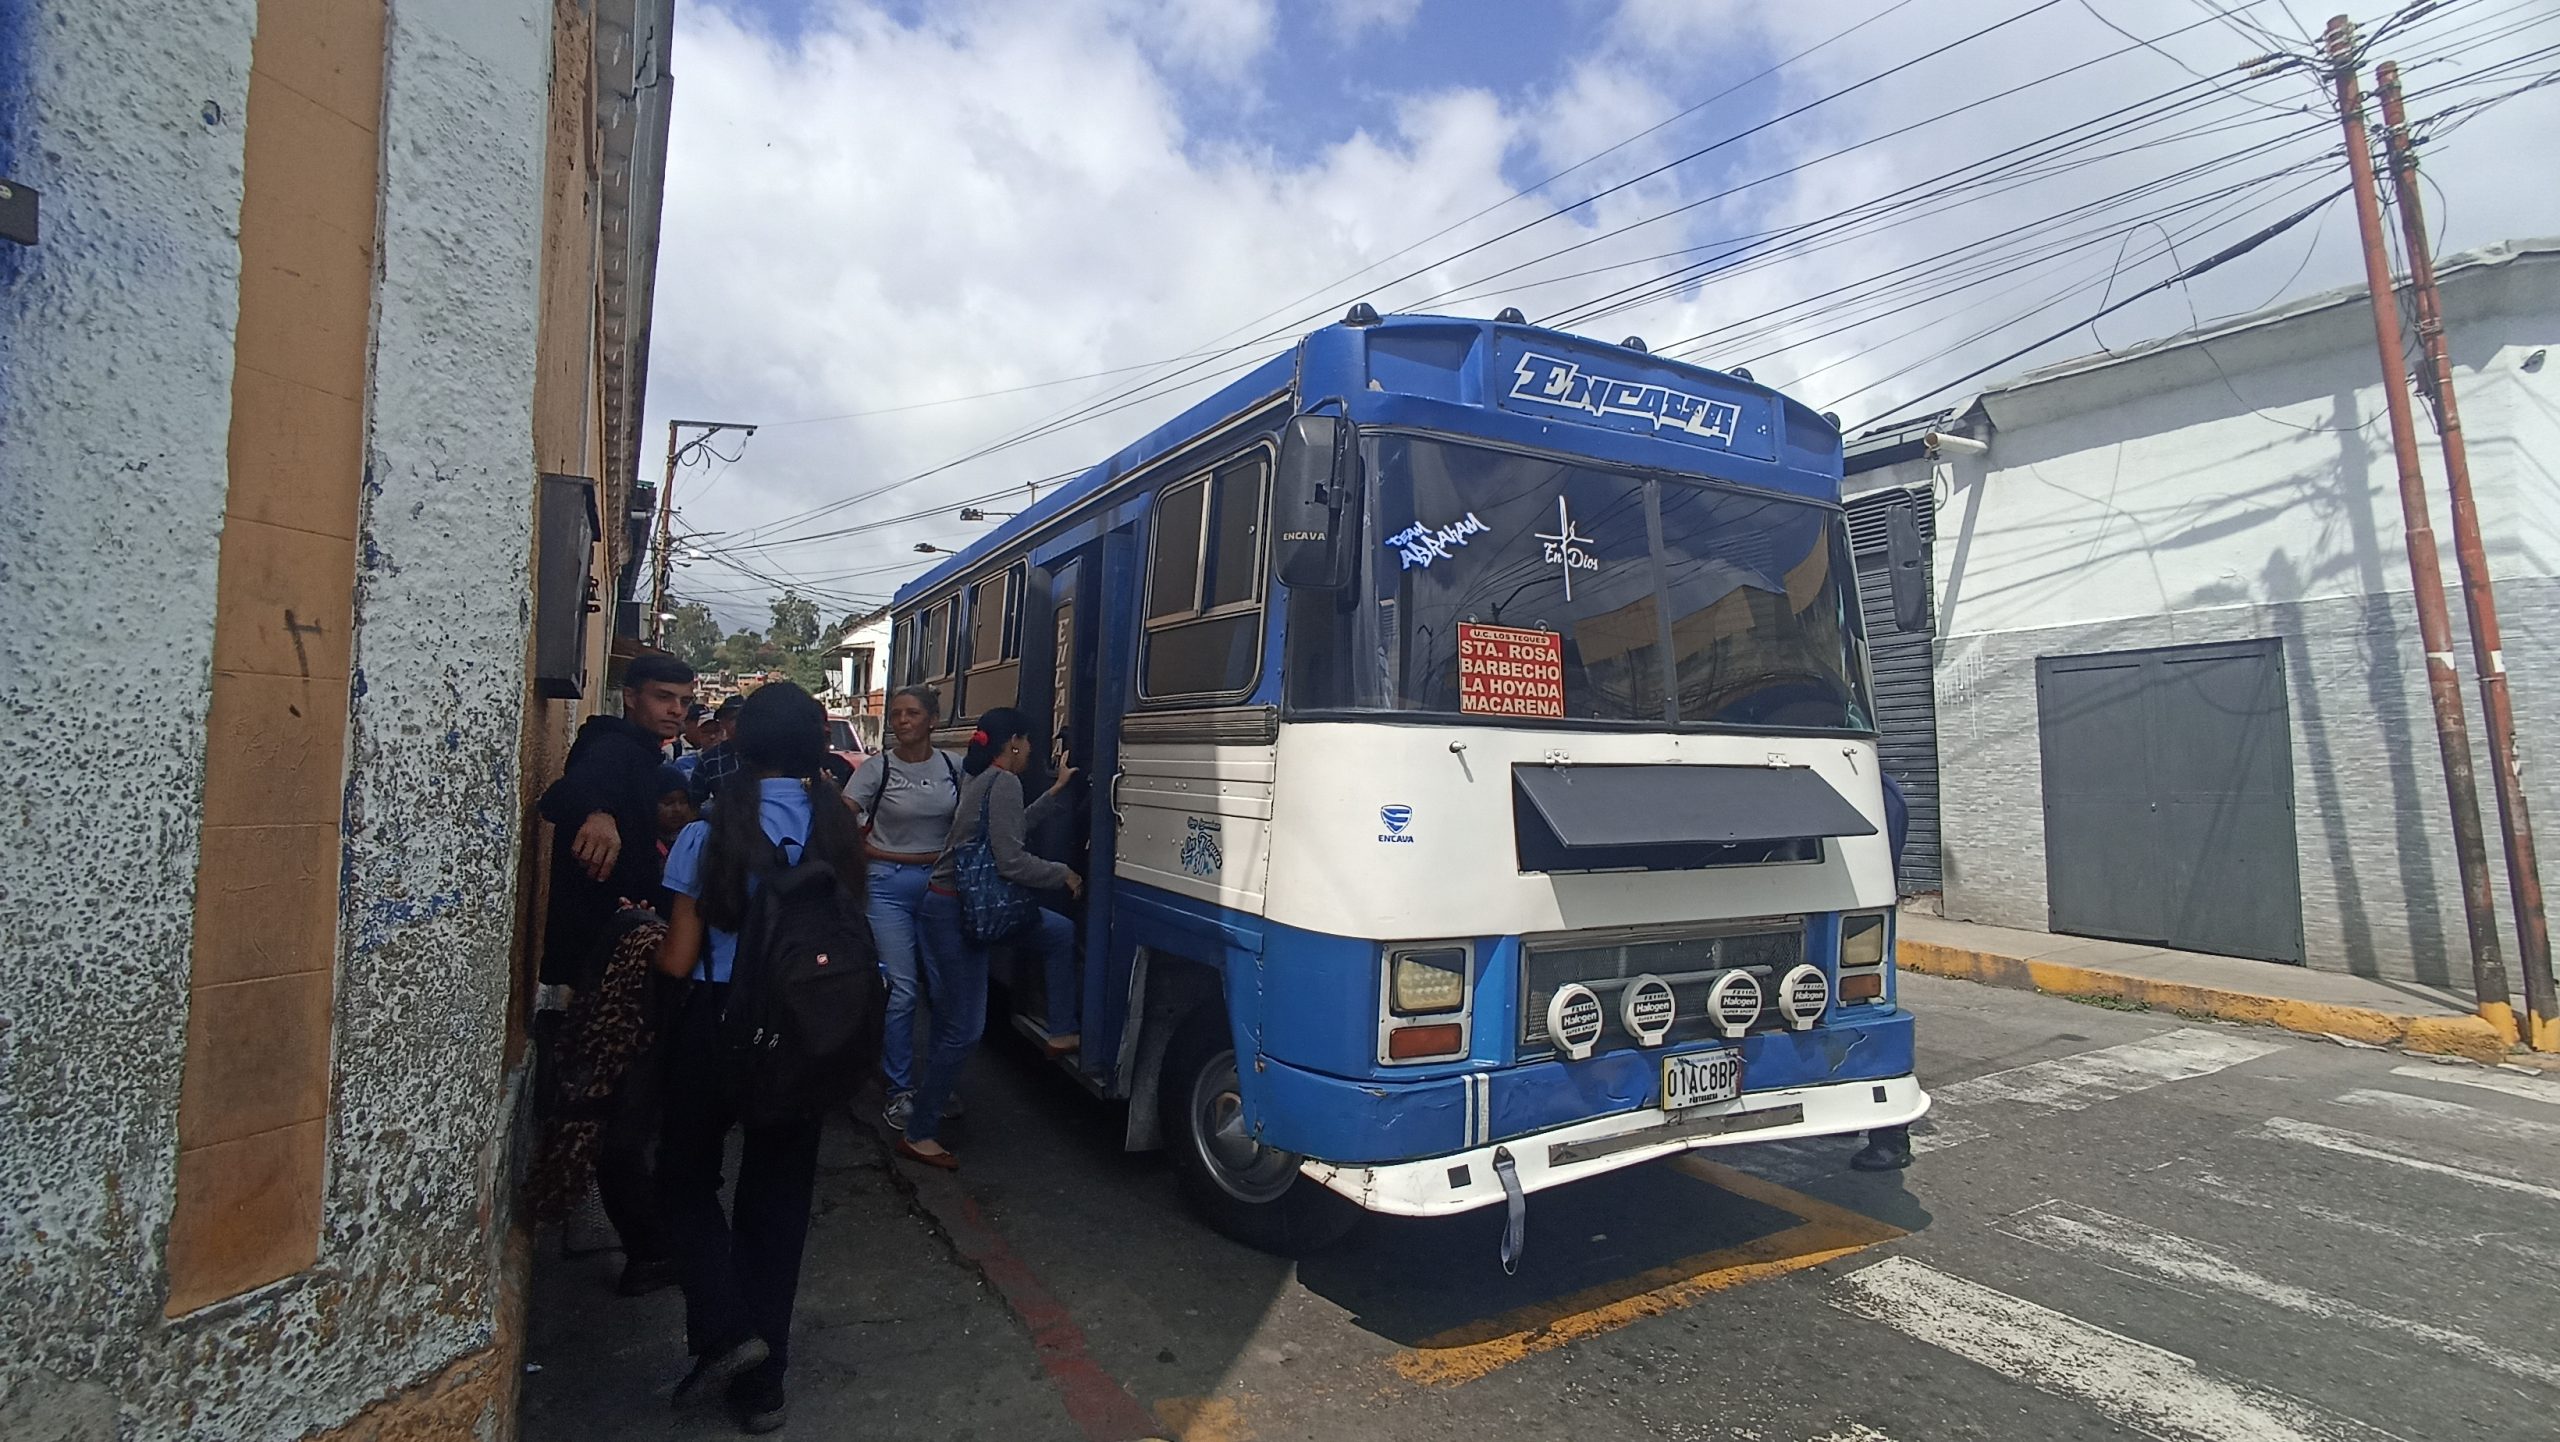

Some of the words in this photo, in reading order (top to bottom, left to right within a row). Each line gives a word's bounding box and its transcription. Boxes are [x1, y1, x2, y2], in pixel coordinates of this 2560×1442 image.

[1509, 352, 1741, 446] ENCAVA
[1283, 531, 1326, 541] ENCAVA
[1543, 542, 1563, 563] En
[1567, 547, 1598, 571] Dios
[1493, 632, 1511, 640] LOS
[1512, 634, 1547, 644] TEQUES
[1461, 640, 1503, 658] STA.
[1508, 644, 1559, 663] ROSA
[1461, 658, 1560, 681] BARBECHO
[1461, 676, 1485, 693] LA
[1489, 679, 1560, 698] HOYADA
[1462, 695, 1562, 716] MACARENA
[1378, 834, 1414, 843] ENCAVA
[1722, 996, 1756, 1007] Halogen
[1795, 991, 1824, 1001] Halogen
[1636, 1002, 1670, 1013] Halogen
[1563, 1012, 1597, 1026] Halogen
[1668, 1060, 1737, 1097] 01AC8BP
